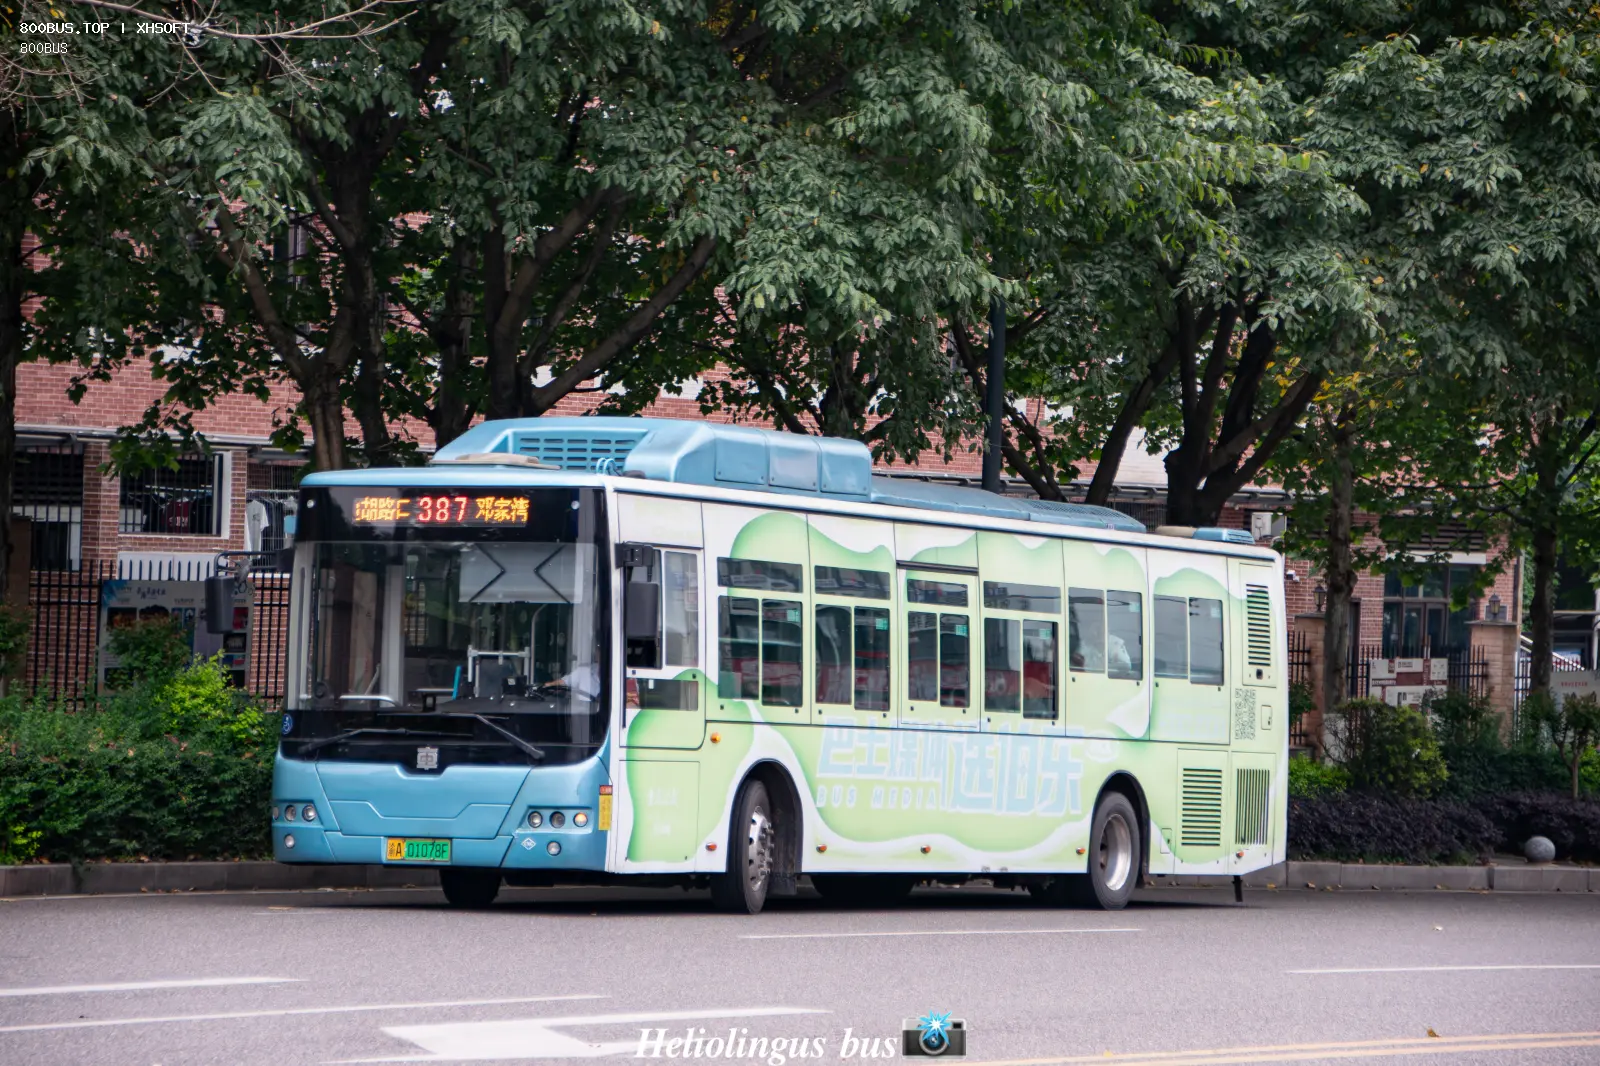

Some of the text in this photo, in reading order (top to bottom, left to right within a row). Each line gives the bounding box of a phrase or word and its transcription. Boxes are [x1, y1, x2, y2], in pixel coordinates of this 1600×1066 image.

[418, 496, 468, 522] 387
[816, 784, 937, 810] BUS MEDIA
